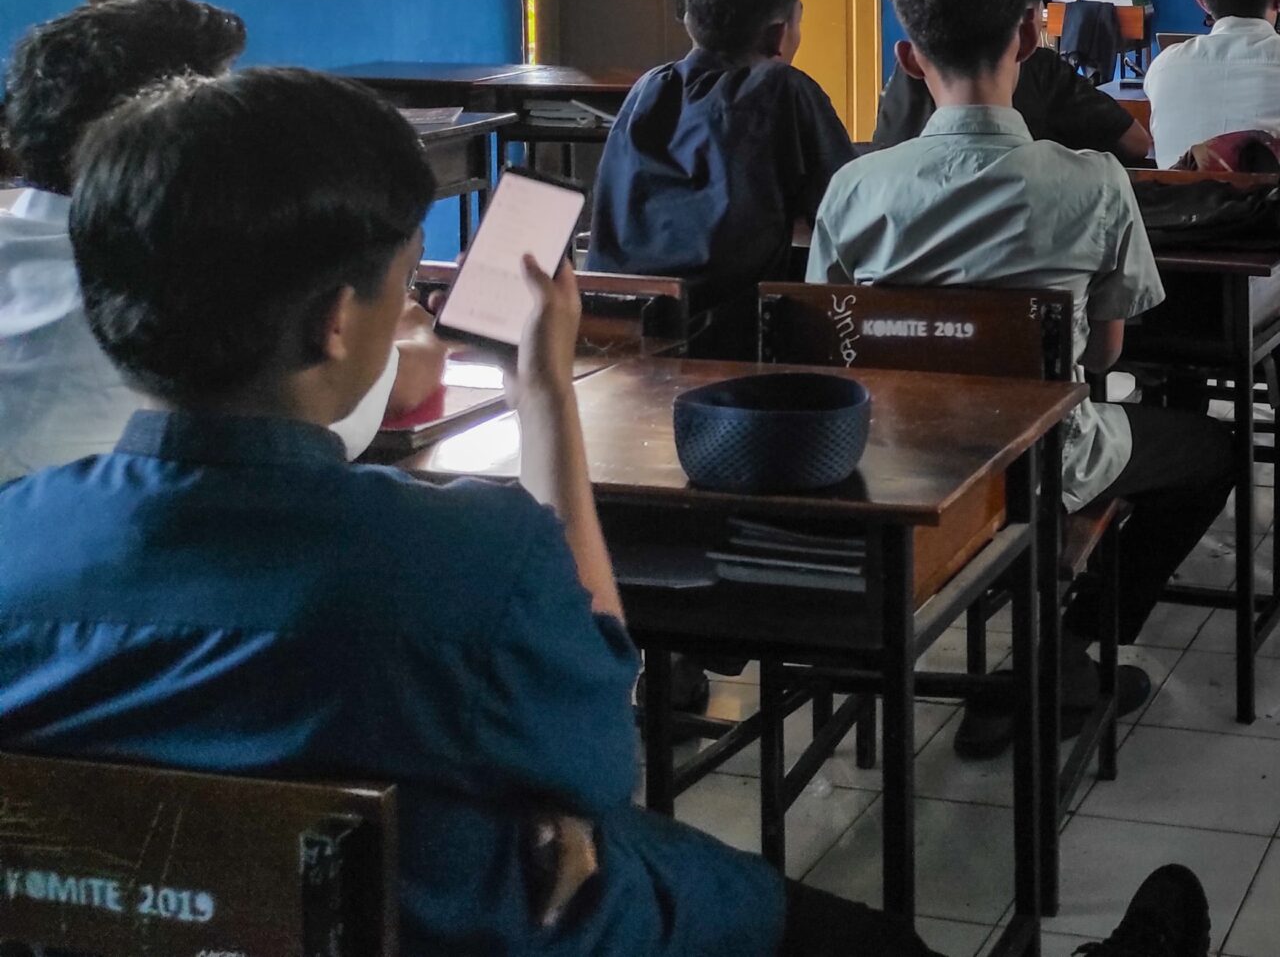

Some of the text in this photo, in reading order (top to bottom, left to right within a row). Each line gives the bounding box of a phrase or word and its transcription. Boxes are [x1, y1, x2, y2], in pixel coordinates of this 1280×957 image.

[863, 319, 974, 338] KOMITE 2019
[137, 884, 214, 923] 2019
